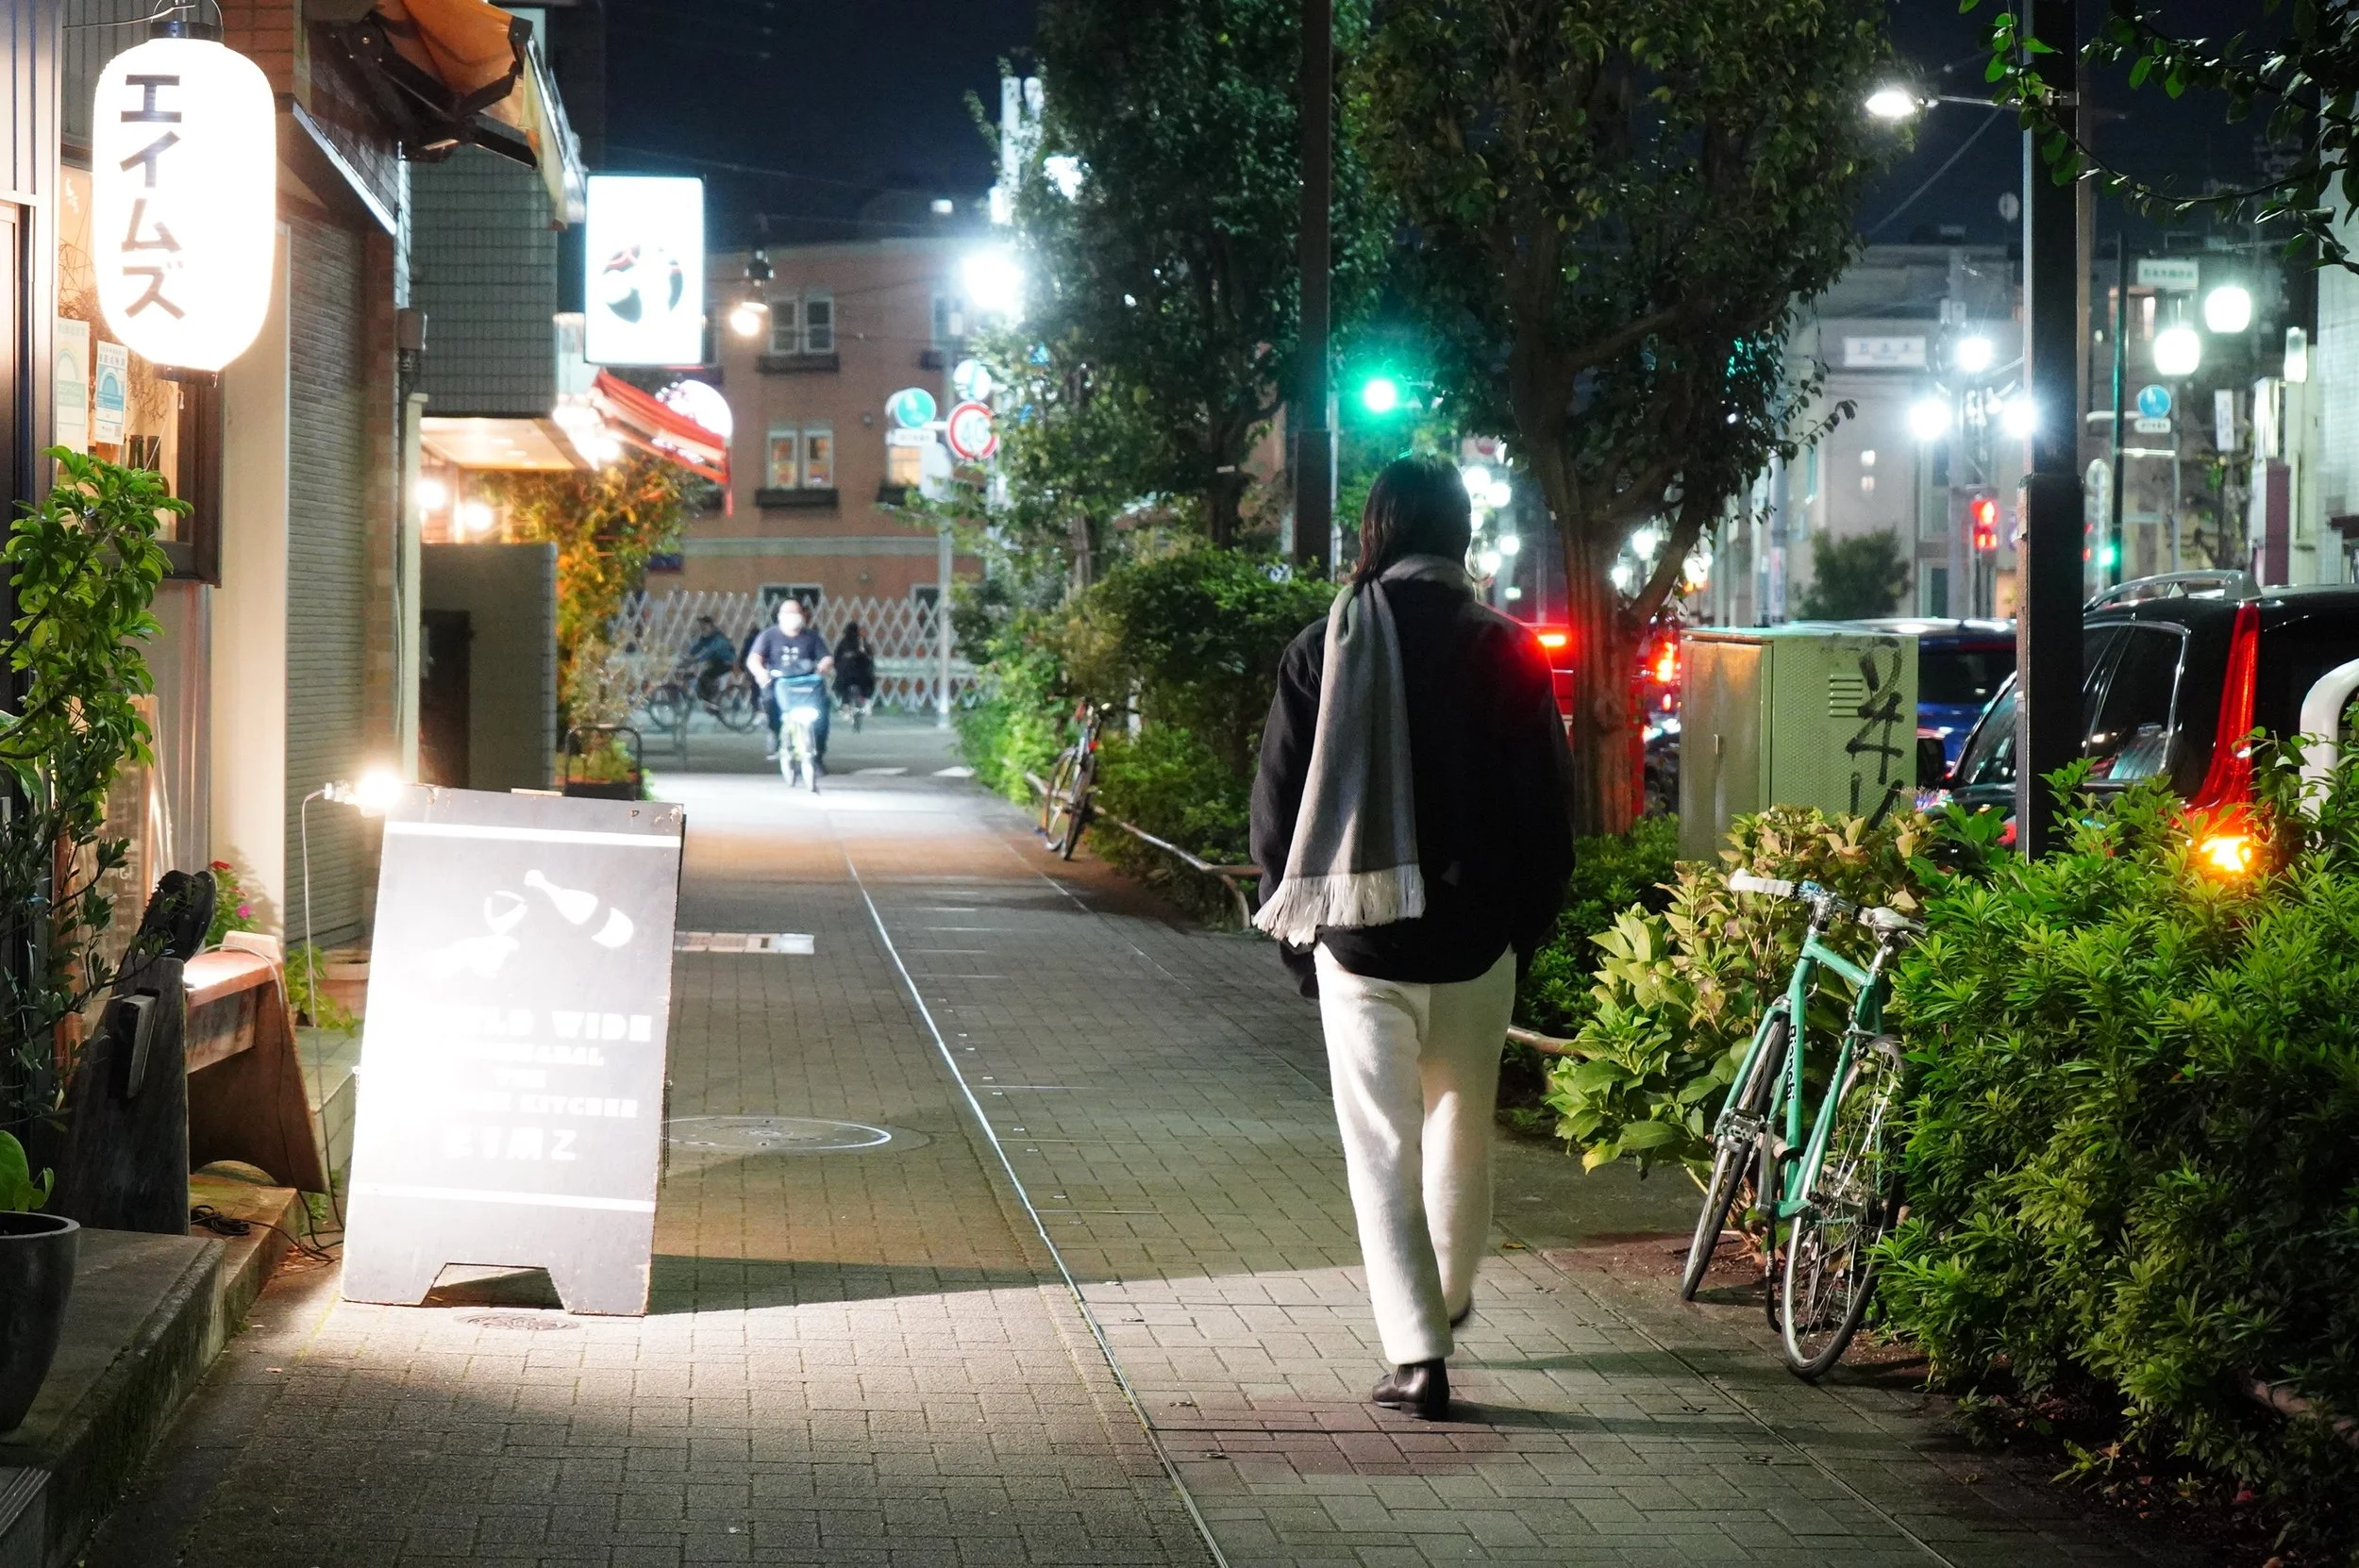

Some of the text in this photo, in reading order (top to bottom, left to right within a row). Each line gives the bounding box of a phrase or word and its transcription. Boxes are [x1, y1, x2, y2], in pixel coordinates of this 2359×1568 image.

[119, 74, 186, 320] エイムズ
[551, 1009, 652, 1043] WIDE
